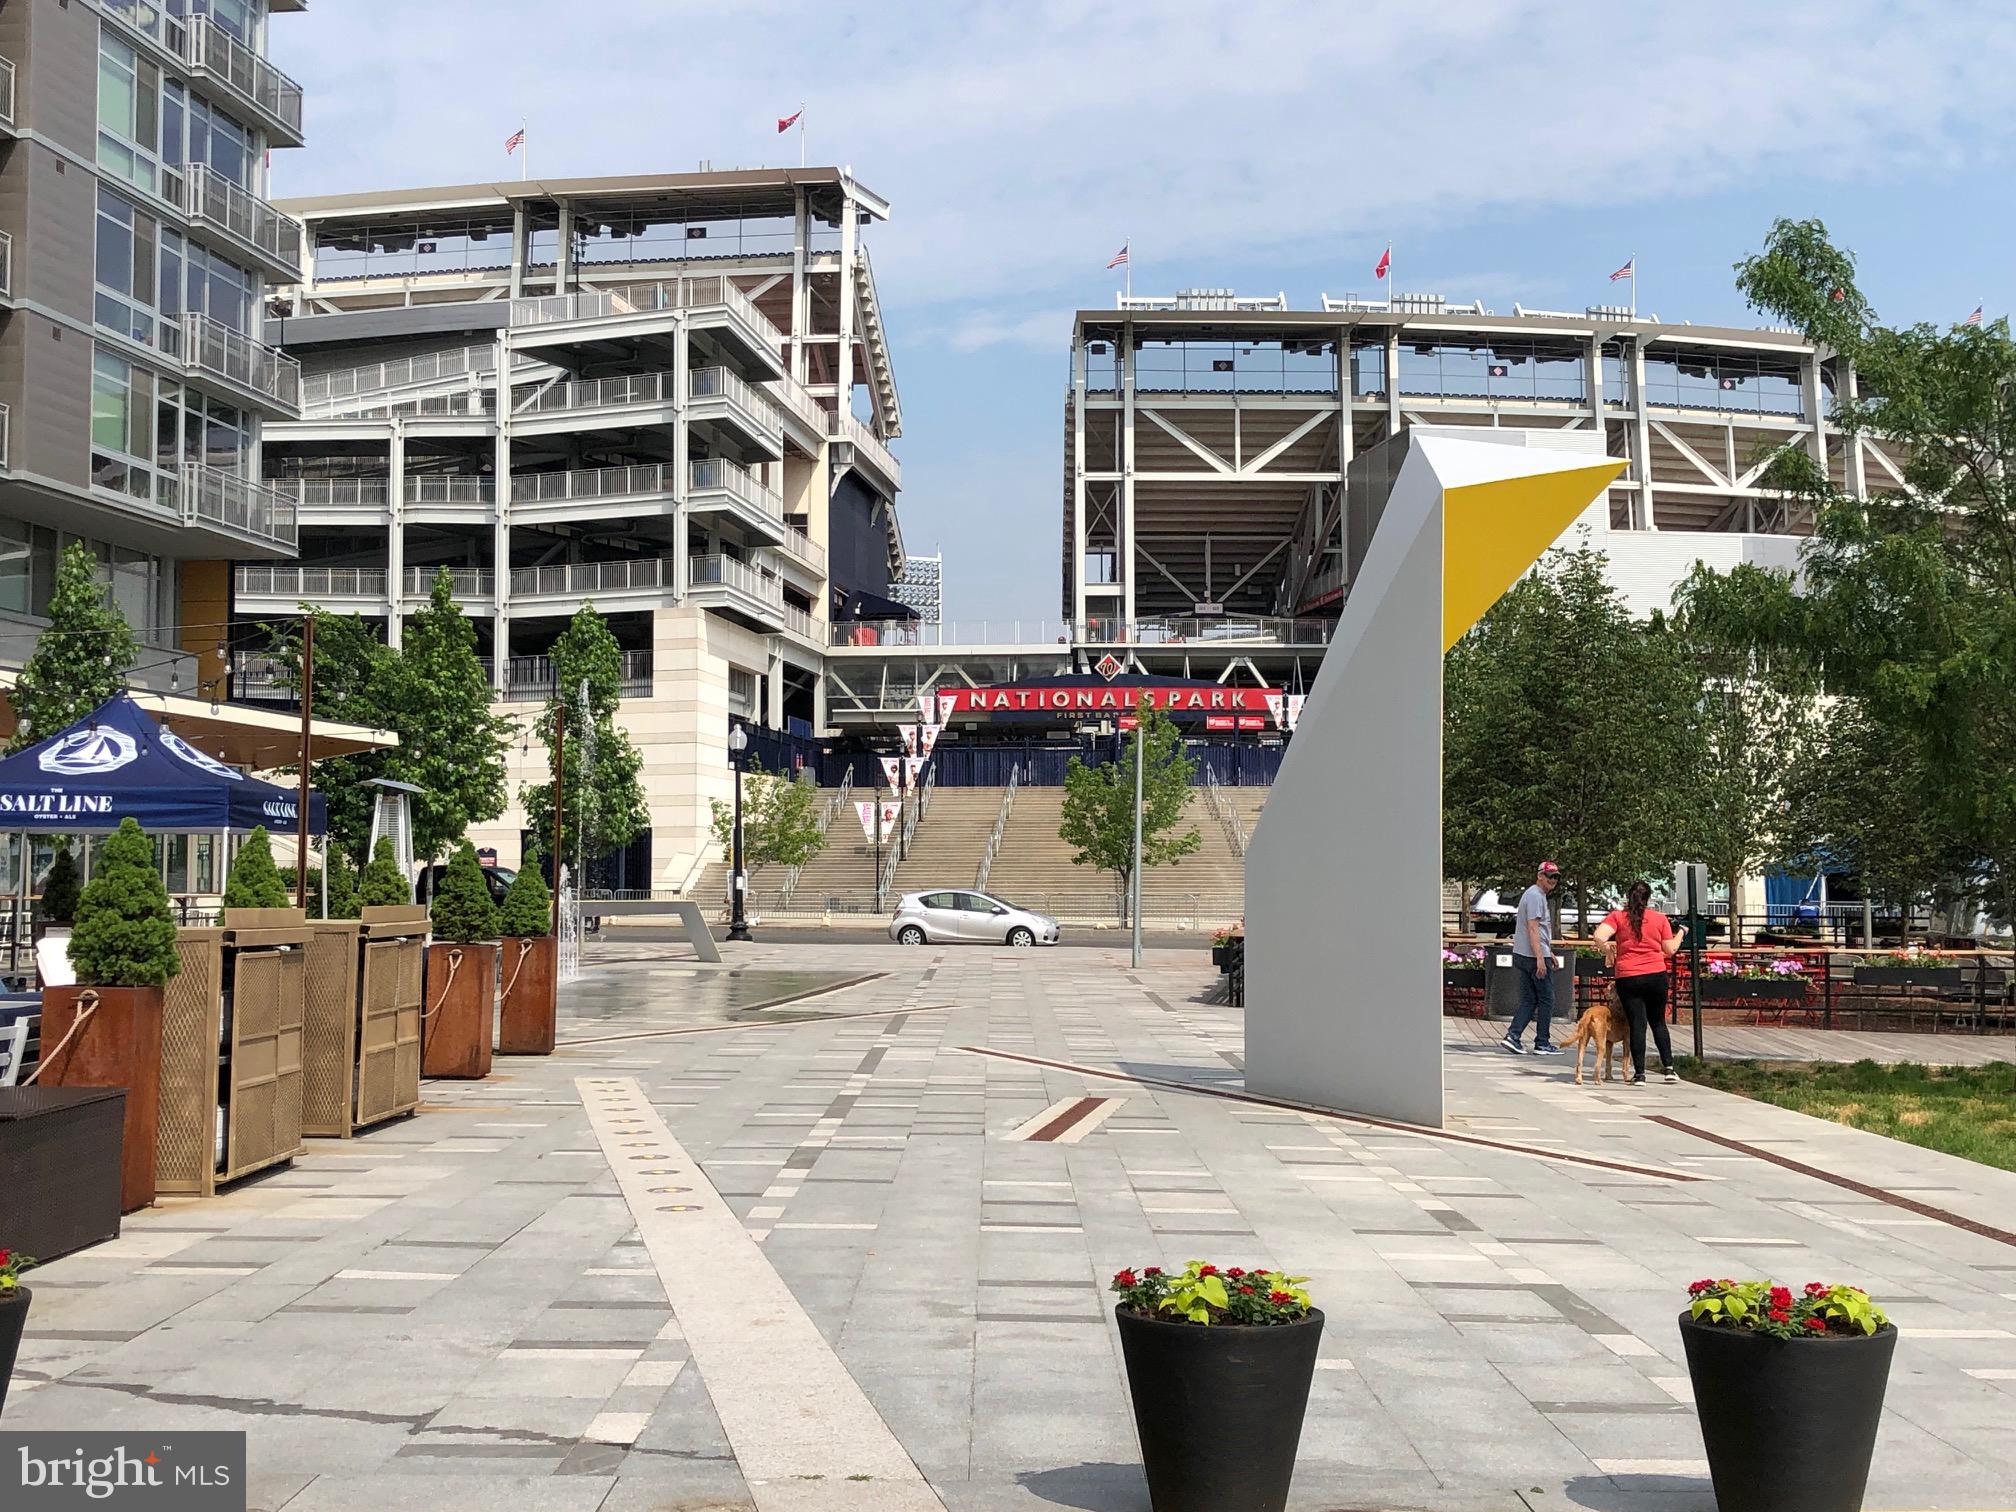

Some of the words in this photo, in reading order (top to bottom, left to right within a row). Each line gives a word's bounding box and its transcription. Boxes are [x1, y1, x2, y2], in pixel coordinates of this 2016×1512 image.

[970, 690, 1155, 708] NATIONALS
[1168, 690, 1246, 707] PARK
[0, 794, 55, 812] SALT
[58, 794, 113, 812] LINE
